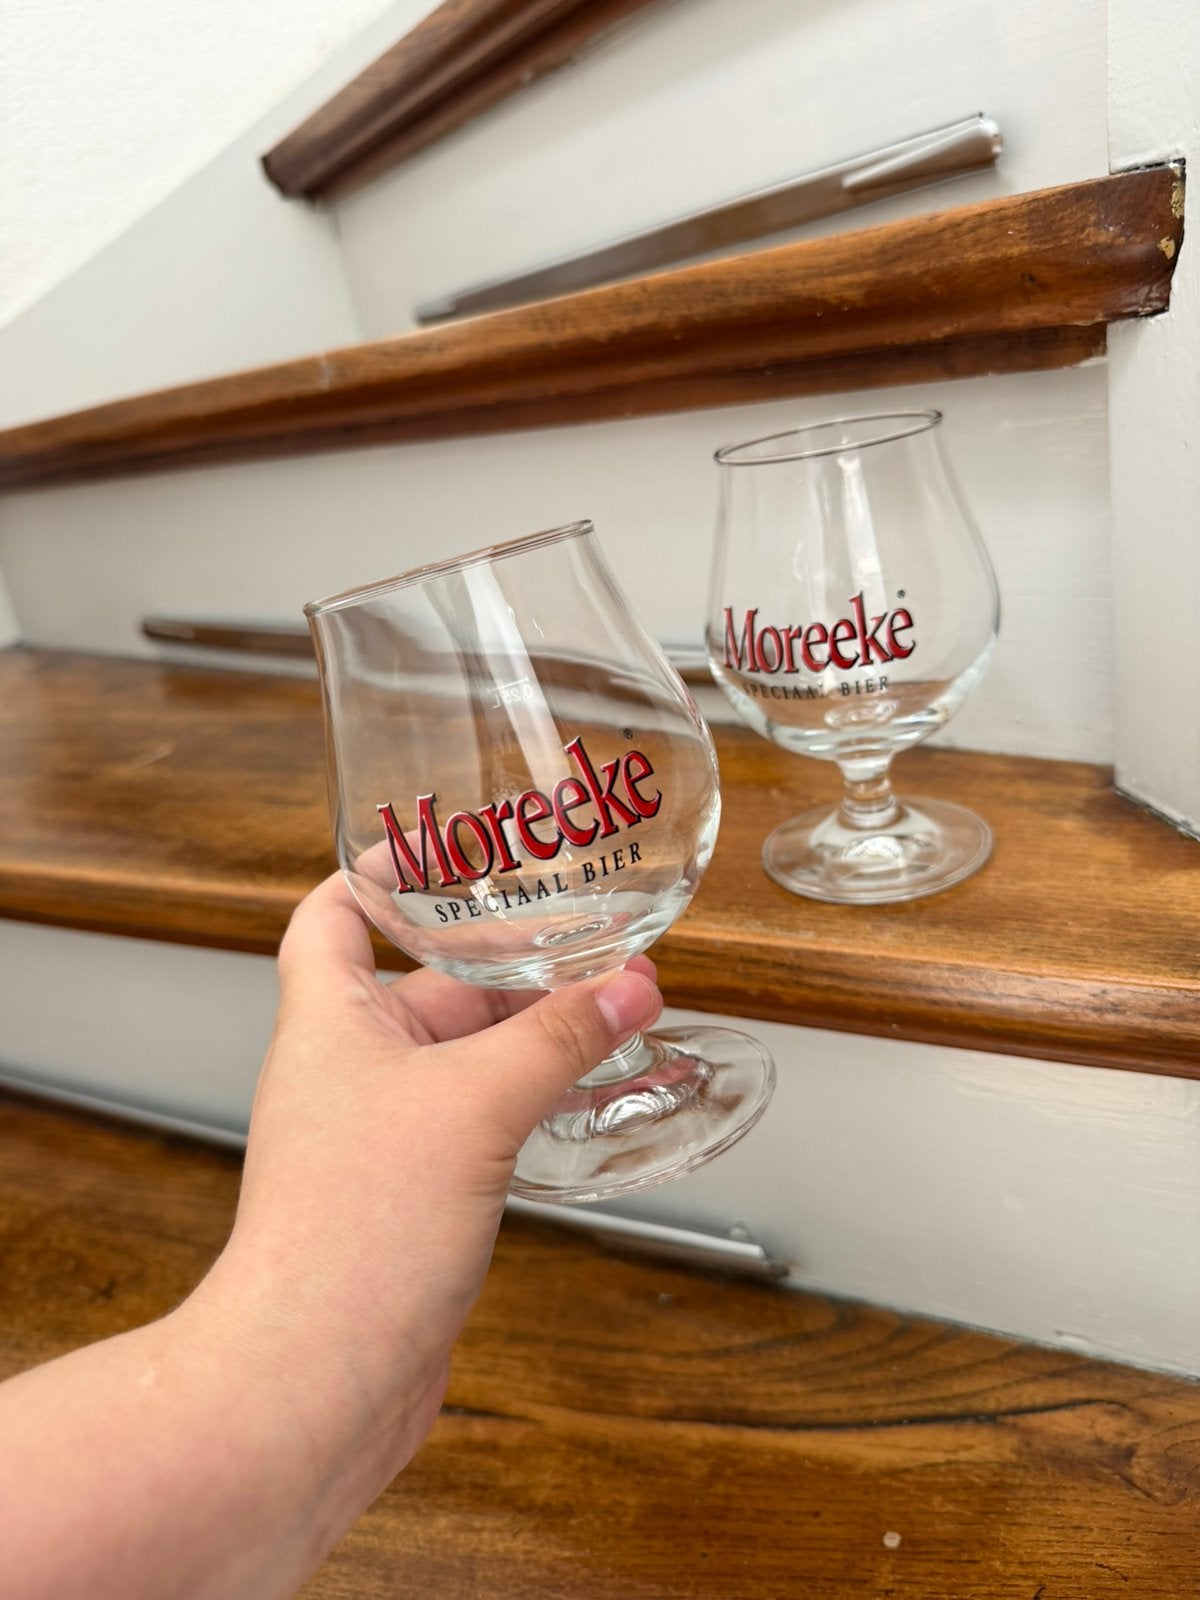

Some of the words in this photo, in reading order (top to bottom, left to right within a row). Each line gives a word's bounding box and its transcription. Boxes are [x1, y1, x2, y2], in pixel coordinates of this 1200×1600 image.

[723, 591, 916, 674] Moreeke
[841, 676, 888, 696] BIER
[377, 737, 662, 893] Moreeke
[434, 873, 568, 923] SPECIAAL
[582, 842, 642, 883] BIER
